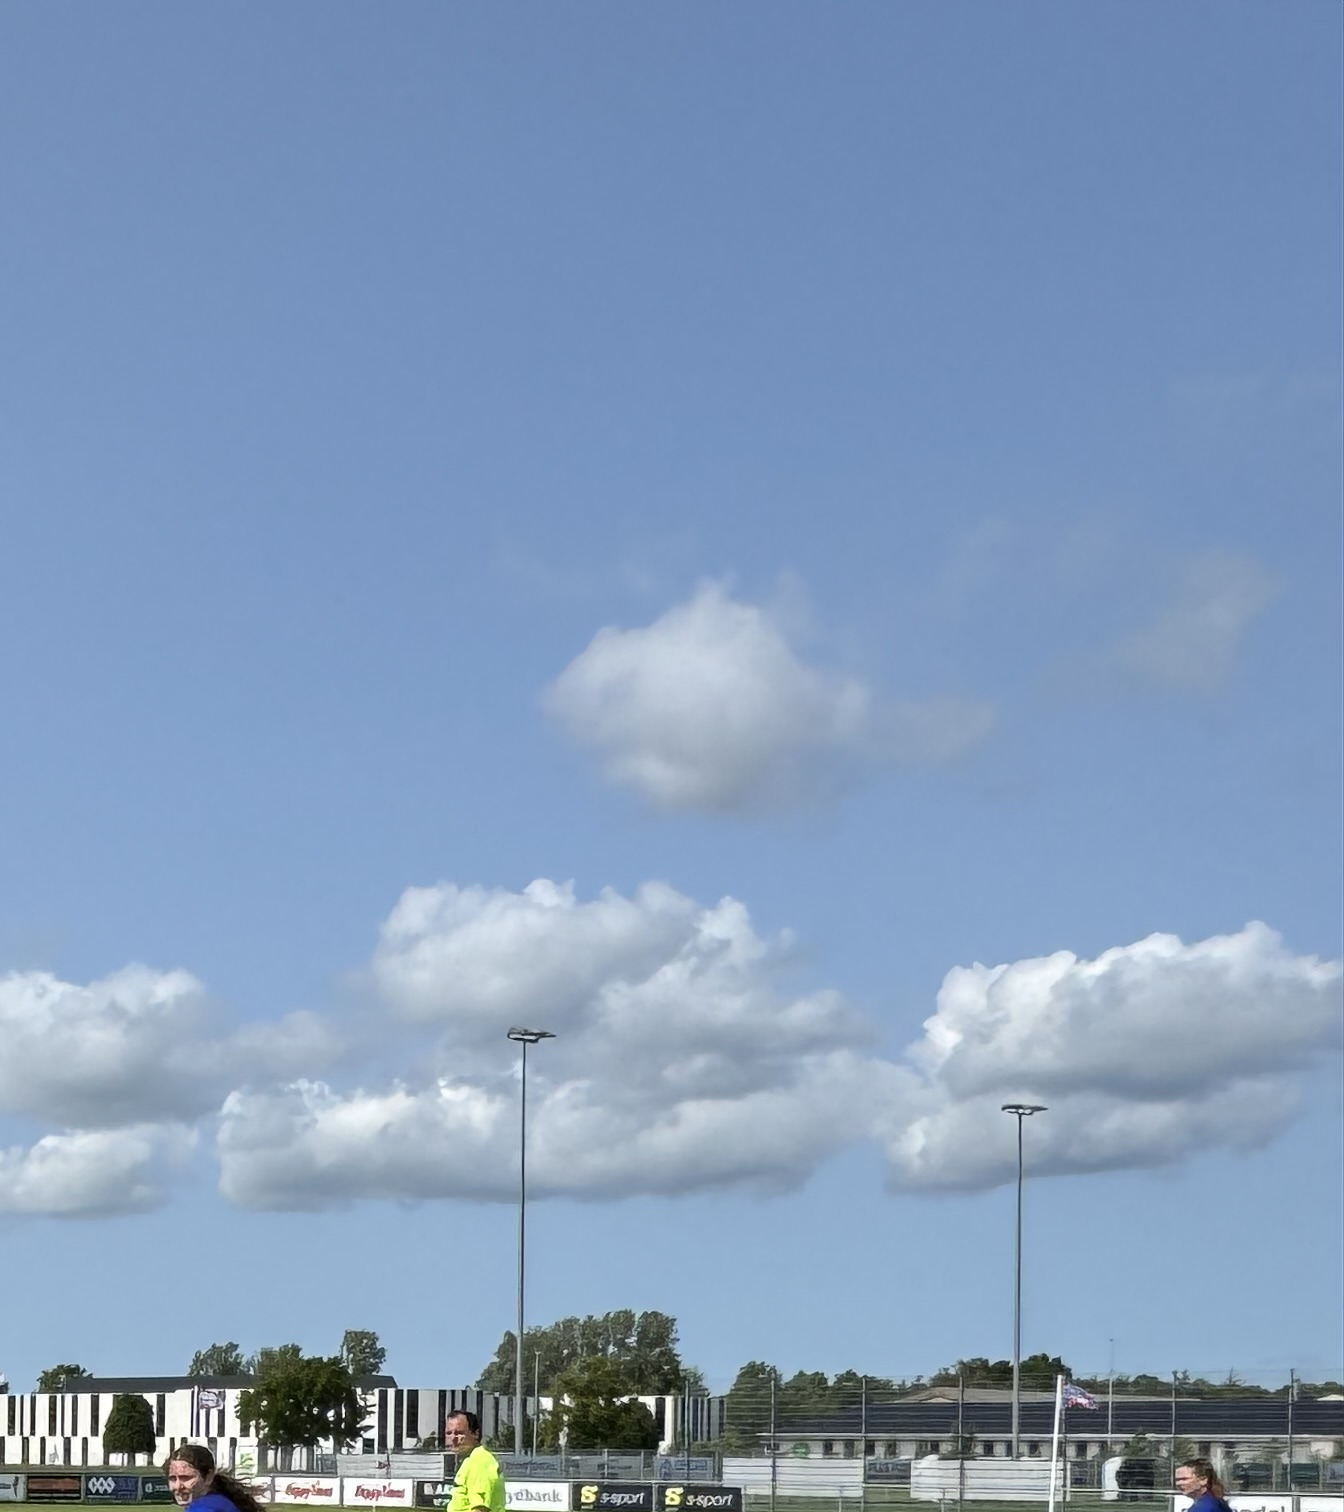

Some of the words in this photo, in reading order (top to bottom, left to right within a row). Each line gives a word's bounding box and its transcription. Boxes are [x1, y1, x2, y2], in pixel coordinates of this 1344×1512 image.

[506, 1489, 562, 1504] ydbank
[600, 1492, 645, 1506] s-sport
[686, 1494, 733, 1508] s-sport
